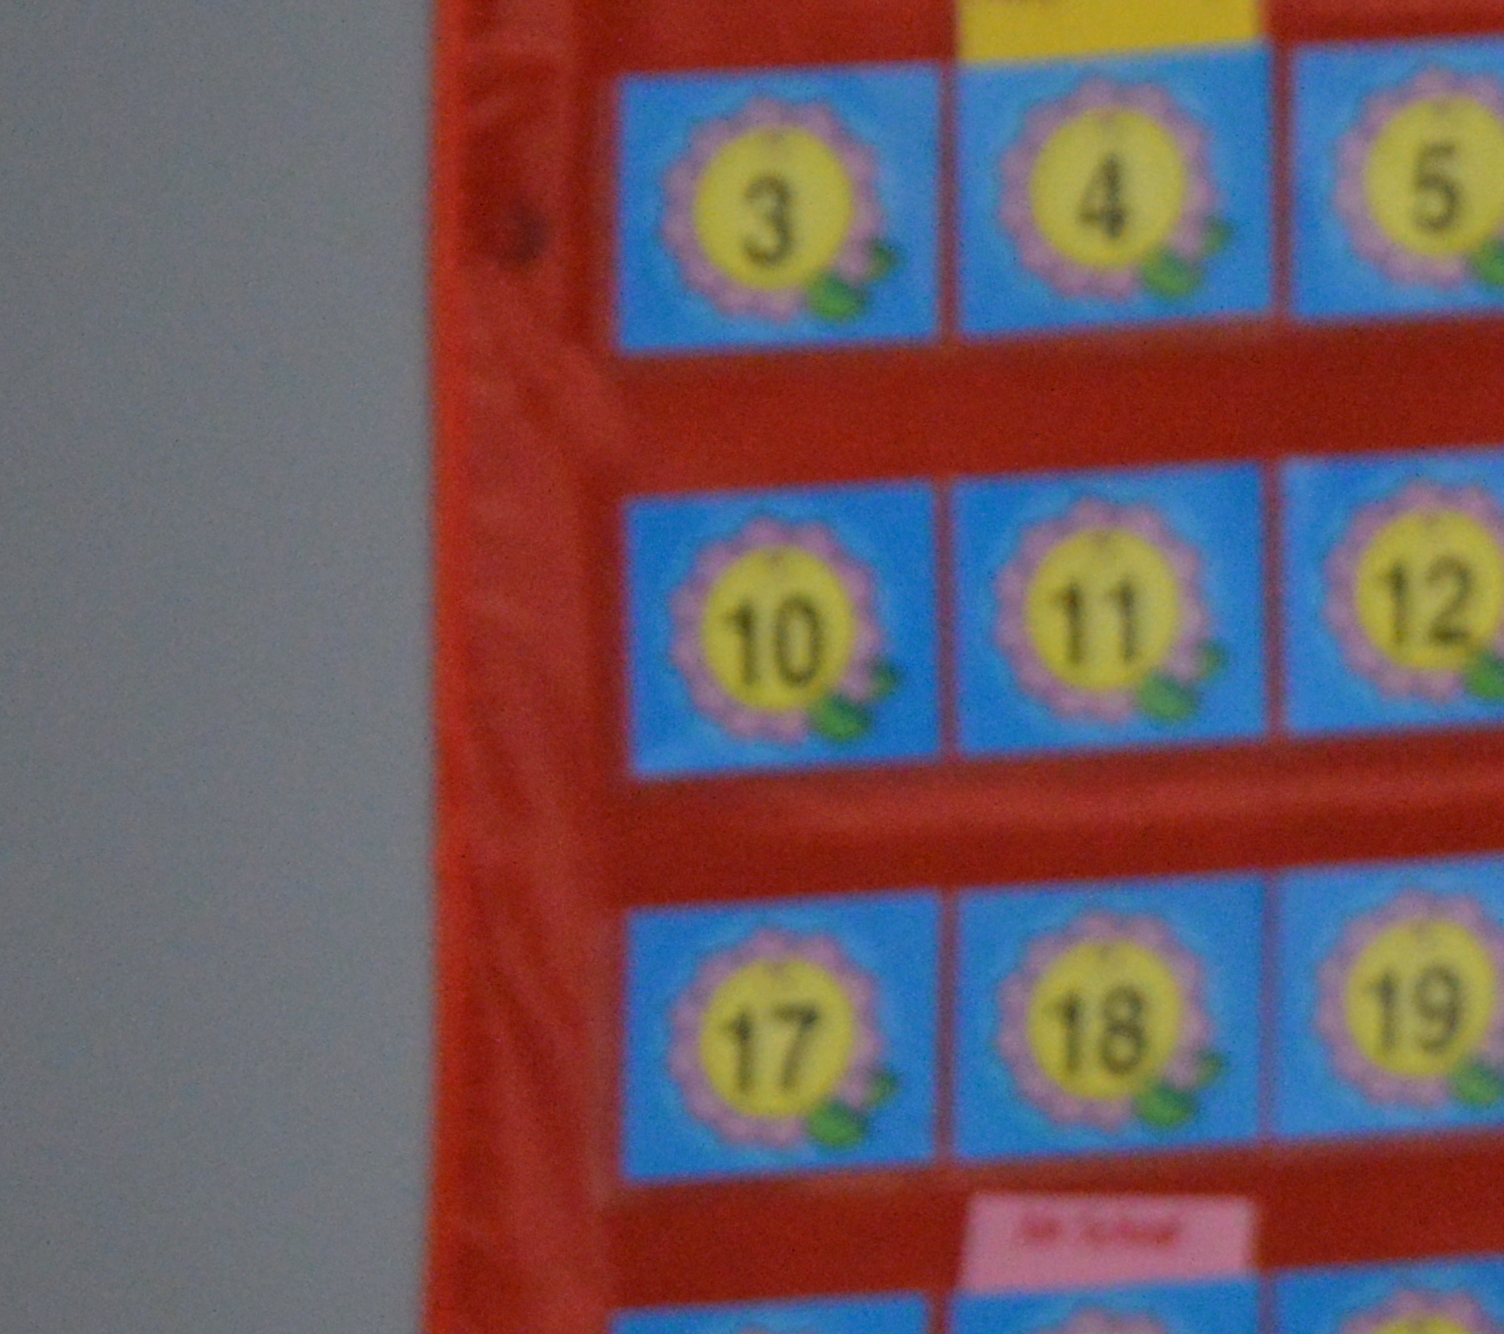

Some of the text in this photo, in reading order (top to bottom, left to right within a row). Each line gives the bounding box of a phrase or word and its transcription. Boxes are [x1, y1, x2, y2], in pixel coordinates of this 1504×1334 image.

[742, 176, 794, 268] 3
[1076, 152, 1127, 241] 4
[1412, 143, 1461, 234] 5
[724, 595, 827, 689] 10
[1050, 578, 1144, 666] 11
[1380, 556, 1476, 649] 12
[724, 1006, 823, 1094] 17
[1050, 985, 1148, 1075] 18
[1367, 964, 1464, 1054] 19
